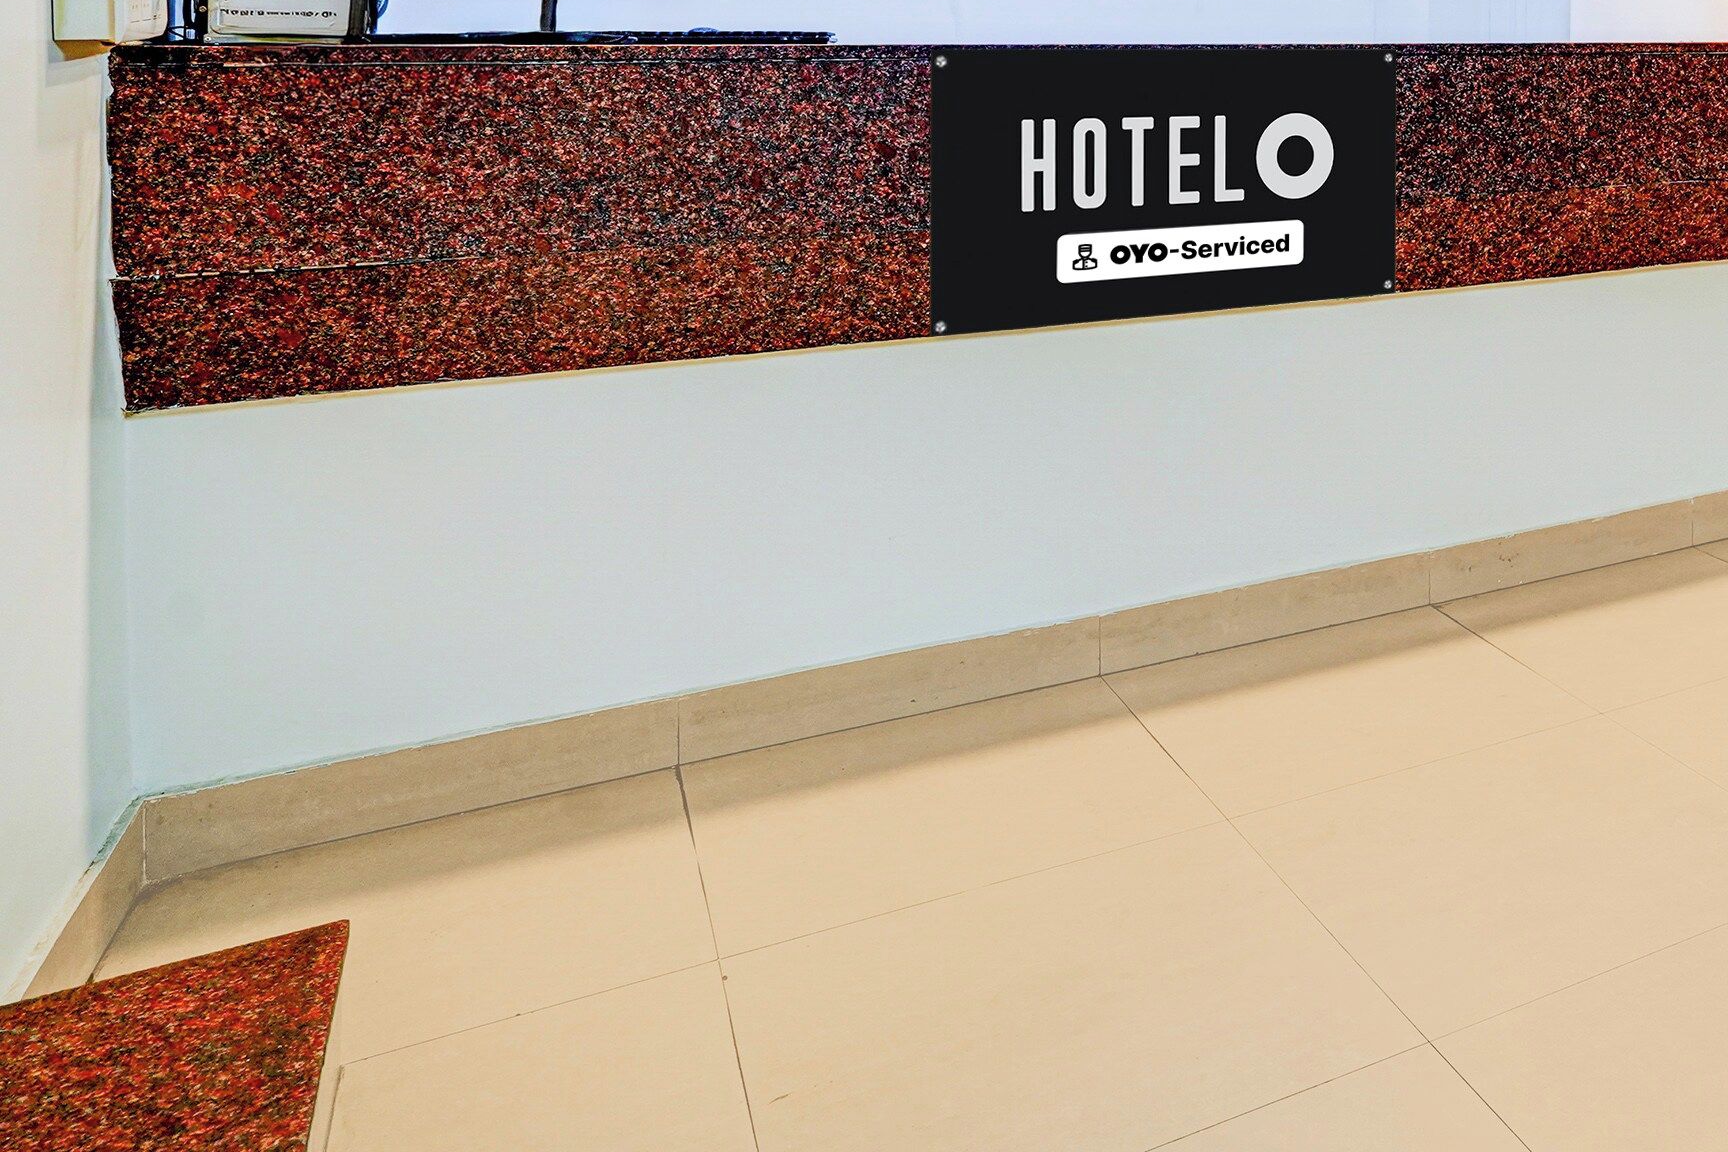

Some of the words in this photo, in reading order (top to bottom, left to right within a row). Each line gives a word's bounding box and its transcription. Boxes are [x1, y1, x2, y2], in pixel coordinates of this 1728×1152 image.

[1021, 115, 1245, 212] HOTEL
[1255, 112, 1334, 199] O
[1110, 234, 1290, 265] OYO-Serviced
